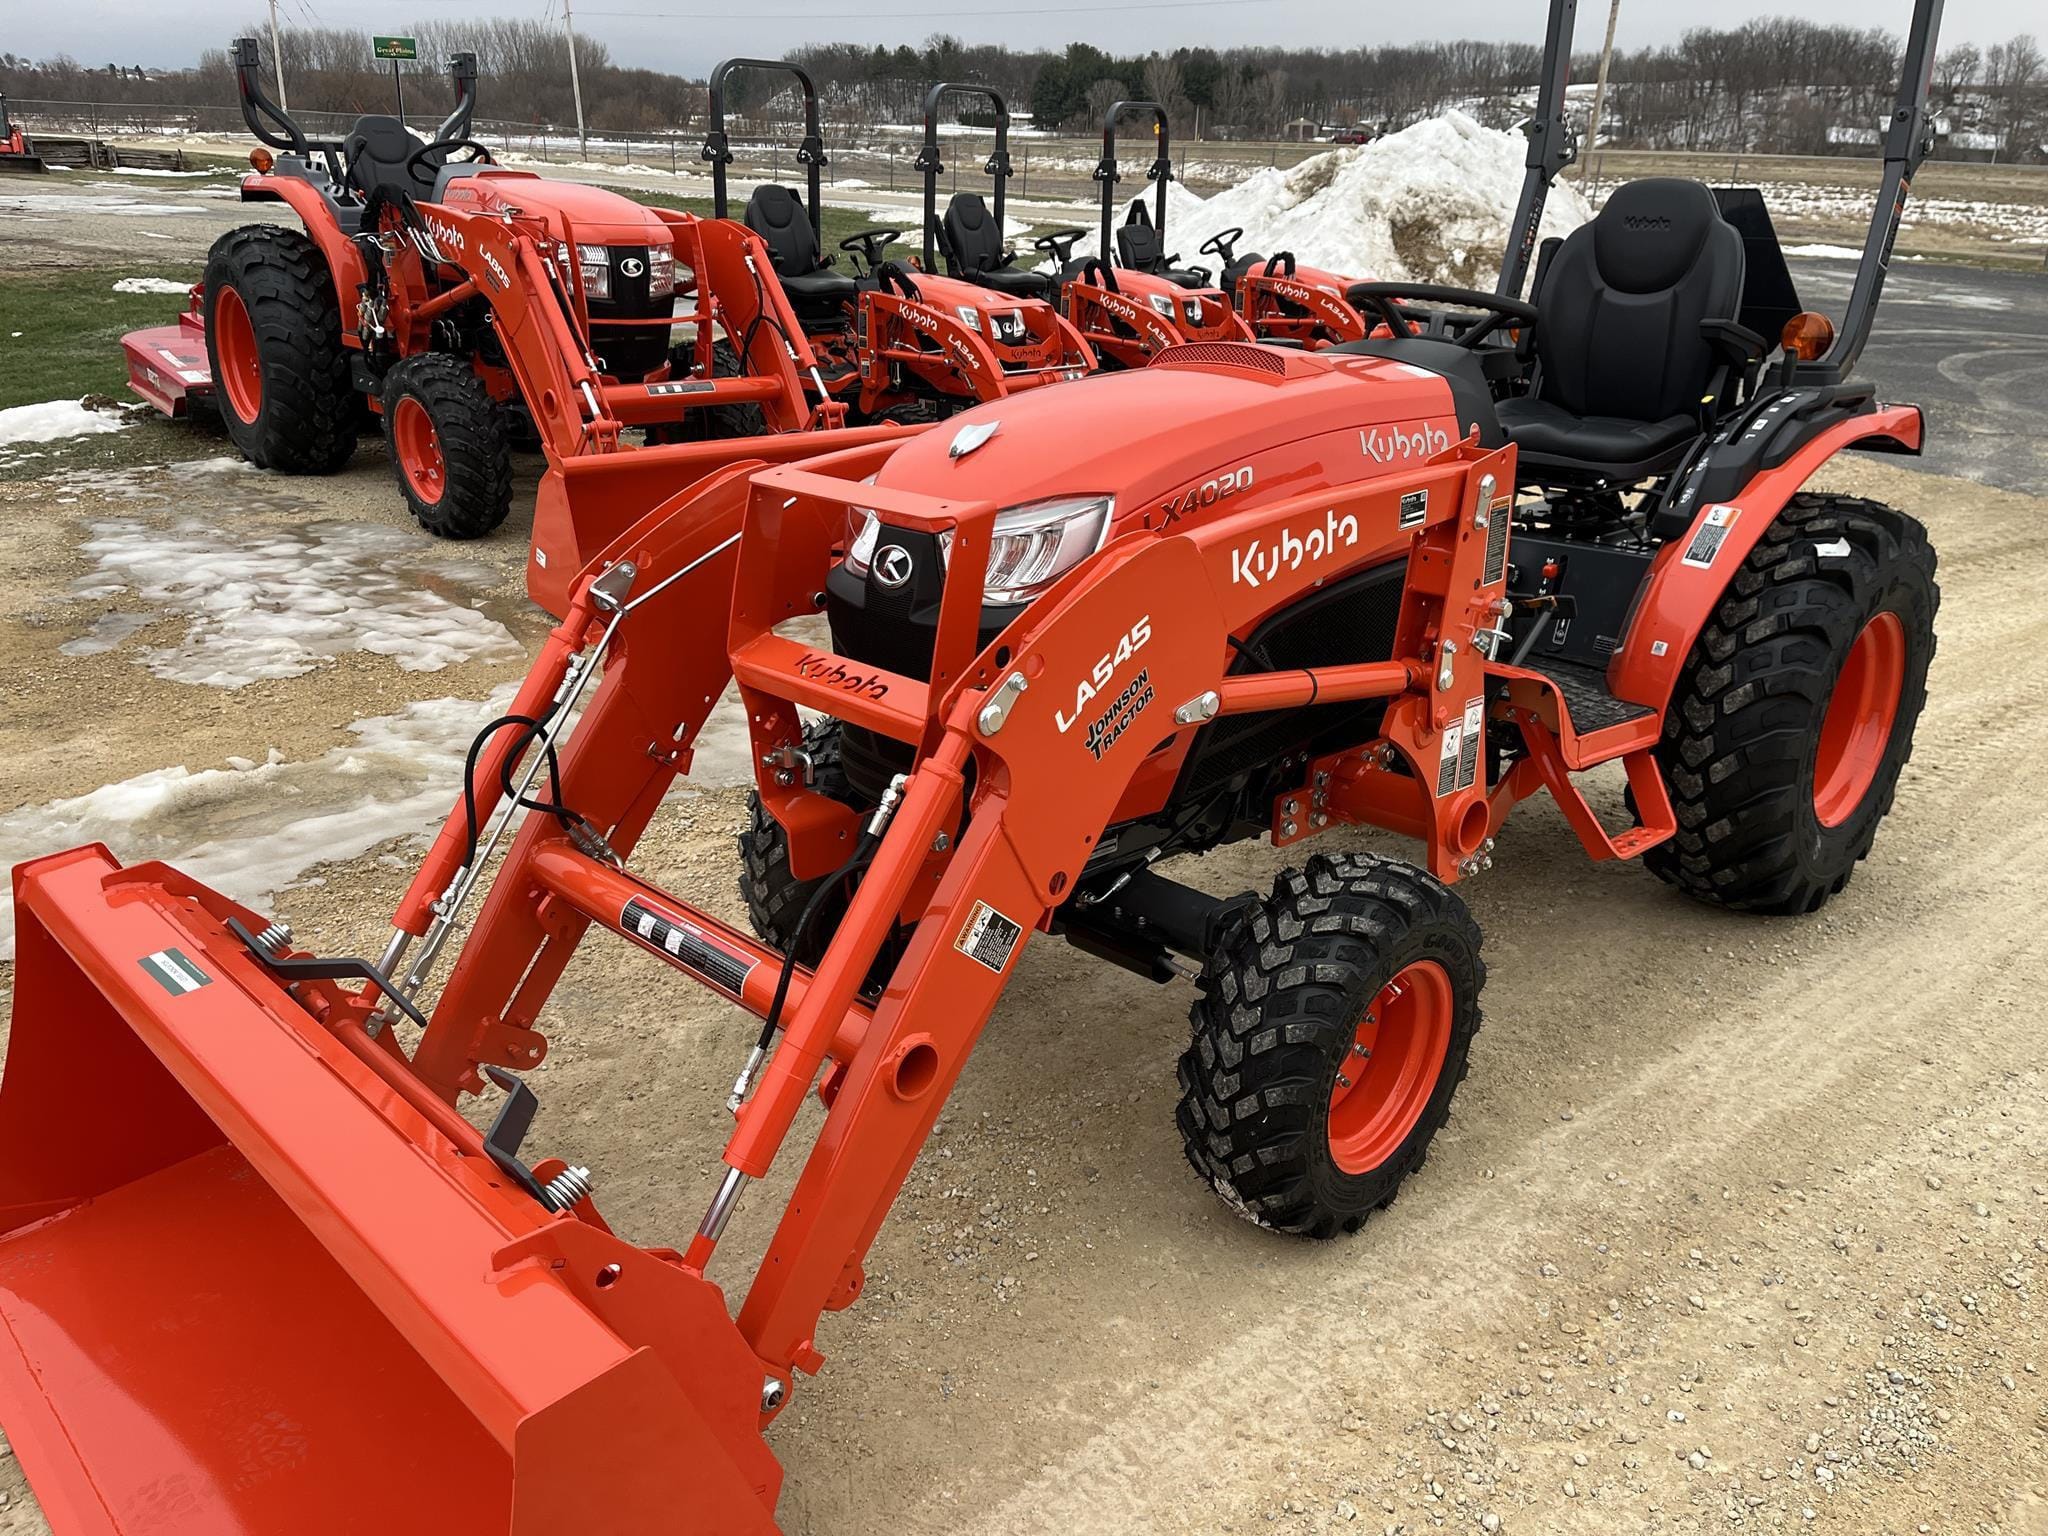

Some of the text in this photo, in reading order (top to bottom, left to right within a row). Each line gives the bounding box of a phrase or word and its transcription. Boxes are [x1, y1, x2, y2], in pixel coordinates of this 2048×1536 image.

[424, 213, 464, 250] Kubota
[1624, 215, 1671, 232] Kubota
[479, 243, 510, 289] LA805
[1100, 293, 1137, 320] Kubota
[1273, 282, 1310, 300] Kubota
[898, 303, 938, 332] Kubota
[1320, 299, 1350, 325] LA344
[947, 333, 980, 371] LA344
[1011, 348, 1042, 359] Kubota
[1359, 422, 1449, 463] Kubota
[1143, 465, 1254, 532] LX4020
[1231, 509, 1359, 588] Kubota
[794, 653, 889, 701] Kubota
[1054, 614, 1152, 734] LA545
[1085, 667, 1149, 748] JOHNSON
[1090, 684, 1156, 762] TRACTOR
